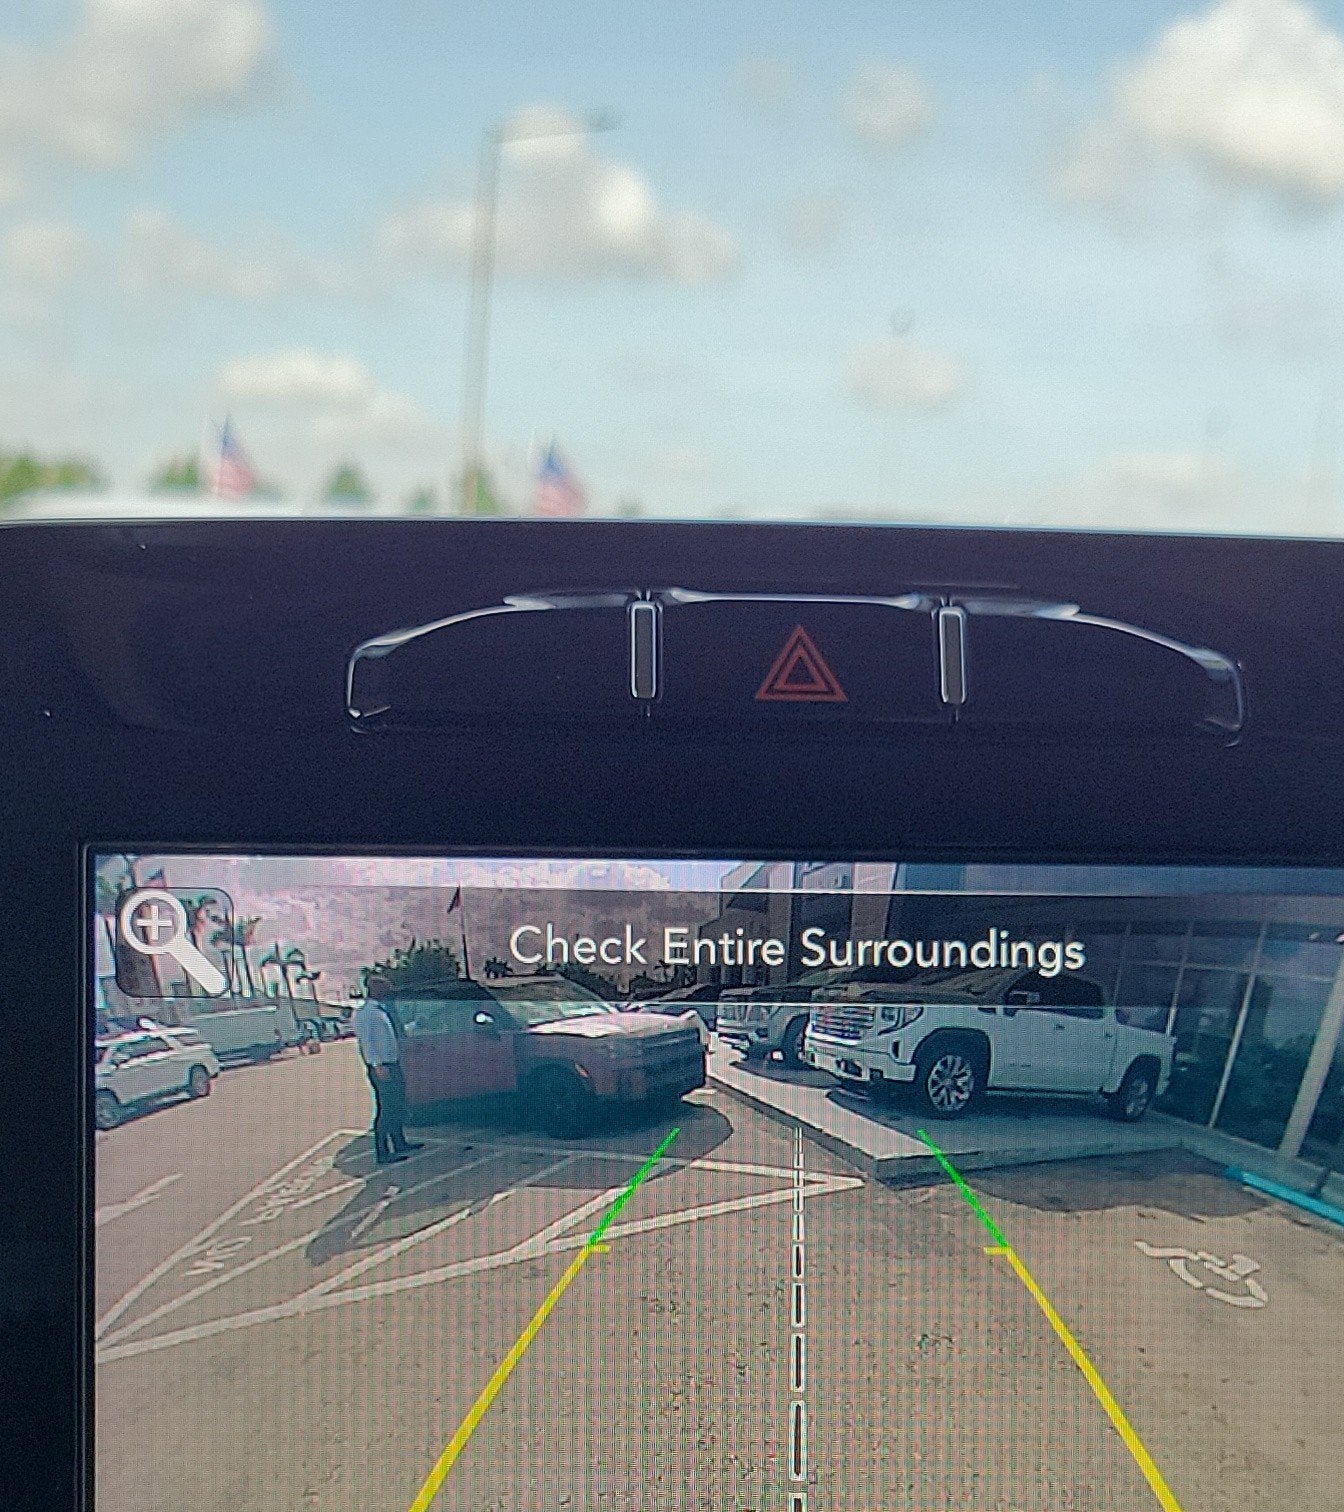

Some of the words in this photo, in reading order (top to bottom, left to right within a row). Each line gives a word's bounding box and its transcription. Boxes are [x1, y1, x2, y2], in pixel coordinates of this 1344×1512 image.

[508, 924, 648, 967] Check
[663, 925, 786, 968] Entire
[799, 927, 1088, 978] Surroundings
